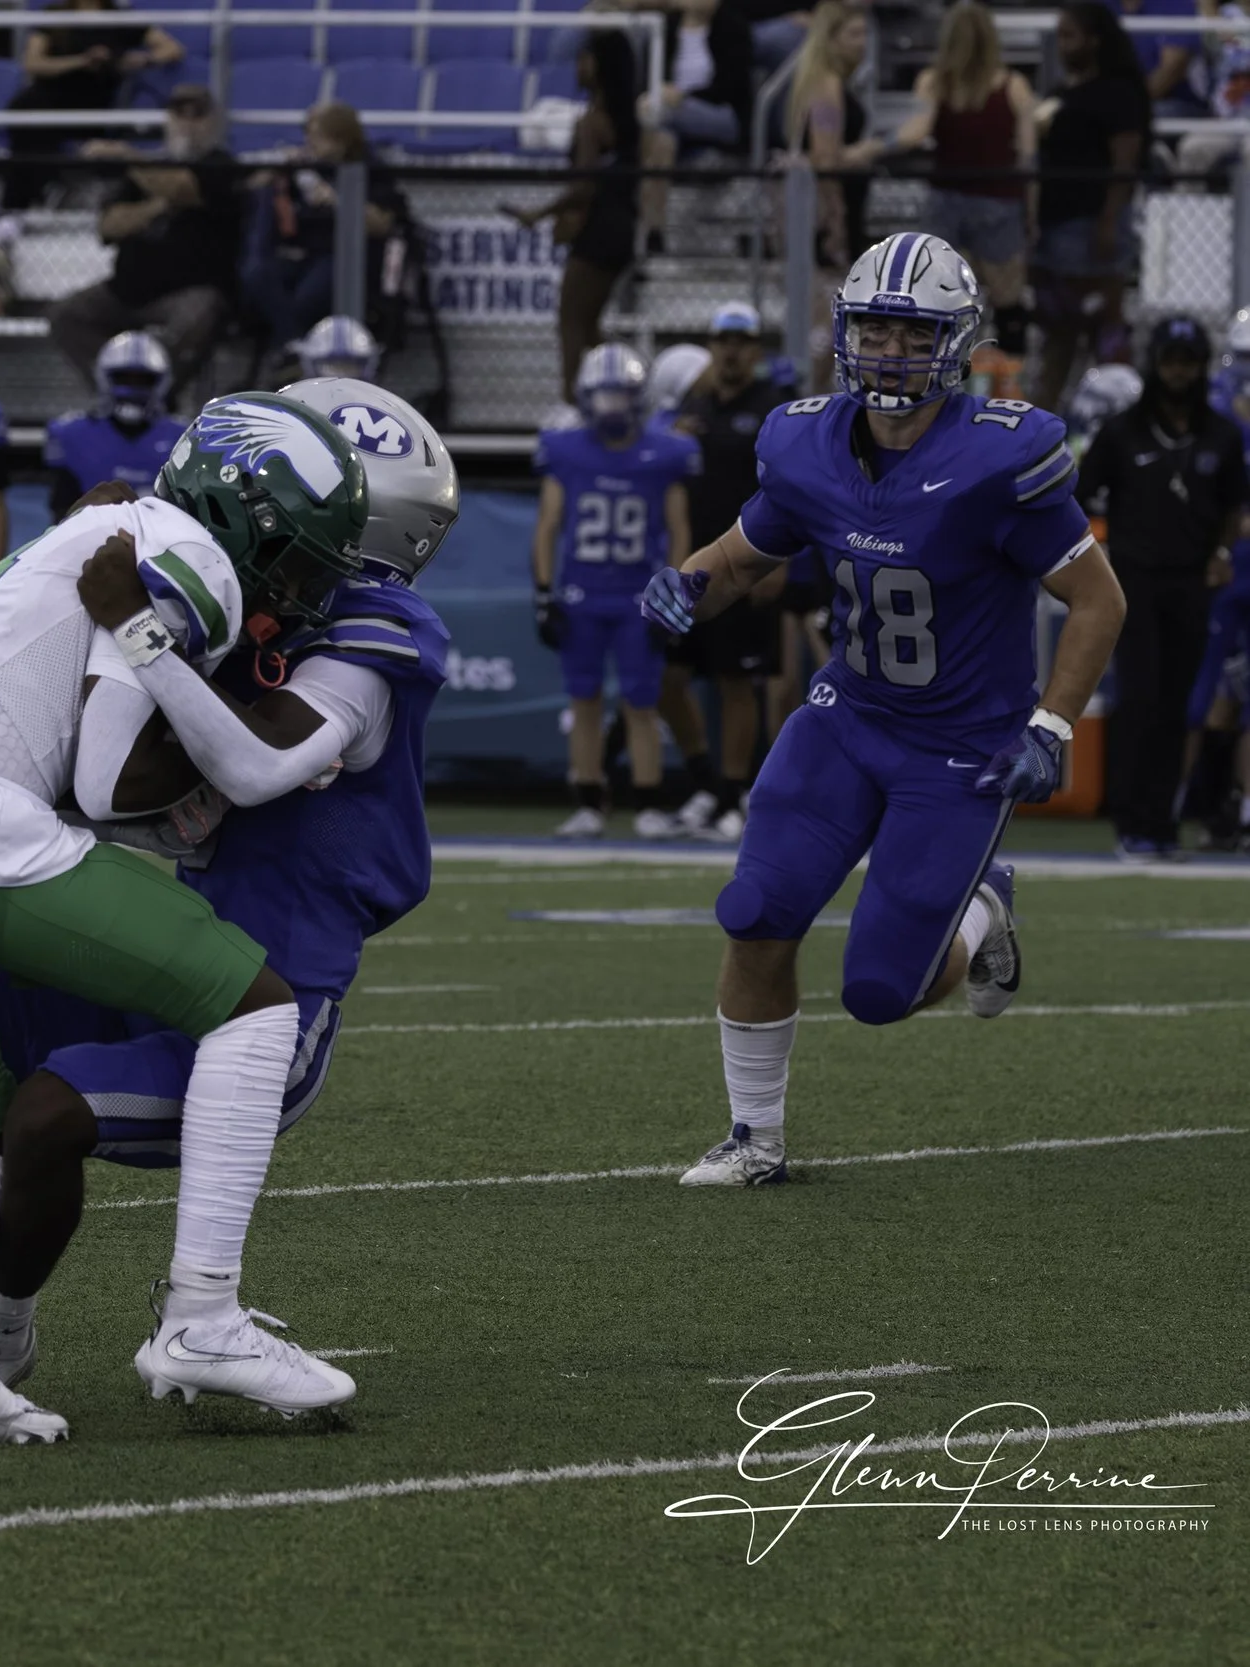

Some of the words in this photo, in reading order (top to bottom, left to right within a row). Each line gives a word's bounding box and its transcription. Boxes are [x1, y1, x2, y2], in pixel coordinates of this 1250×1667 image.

[338, 406, 406, 455] M
[972, 397, 1035, 431] 18
[575, 490, 648, 564] 29
[846, 532, 905, 557] Vikings
[834, 558, 938, 688] 18
[812, 685, 835, 705] M
